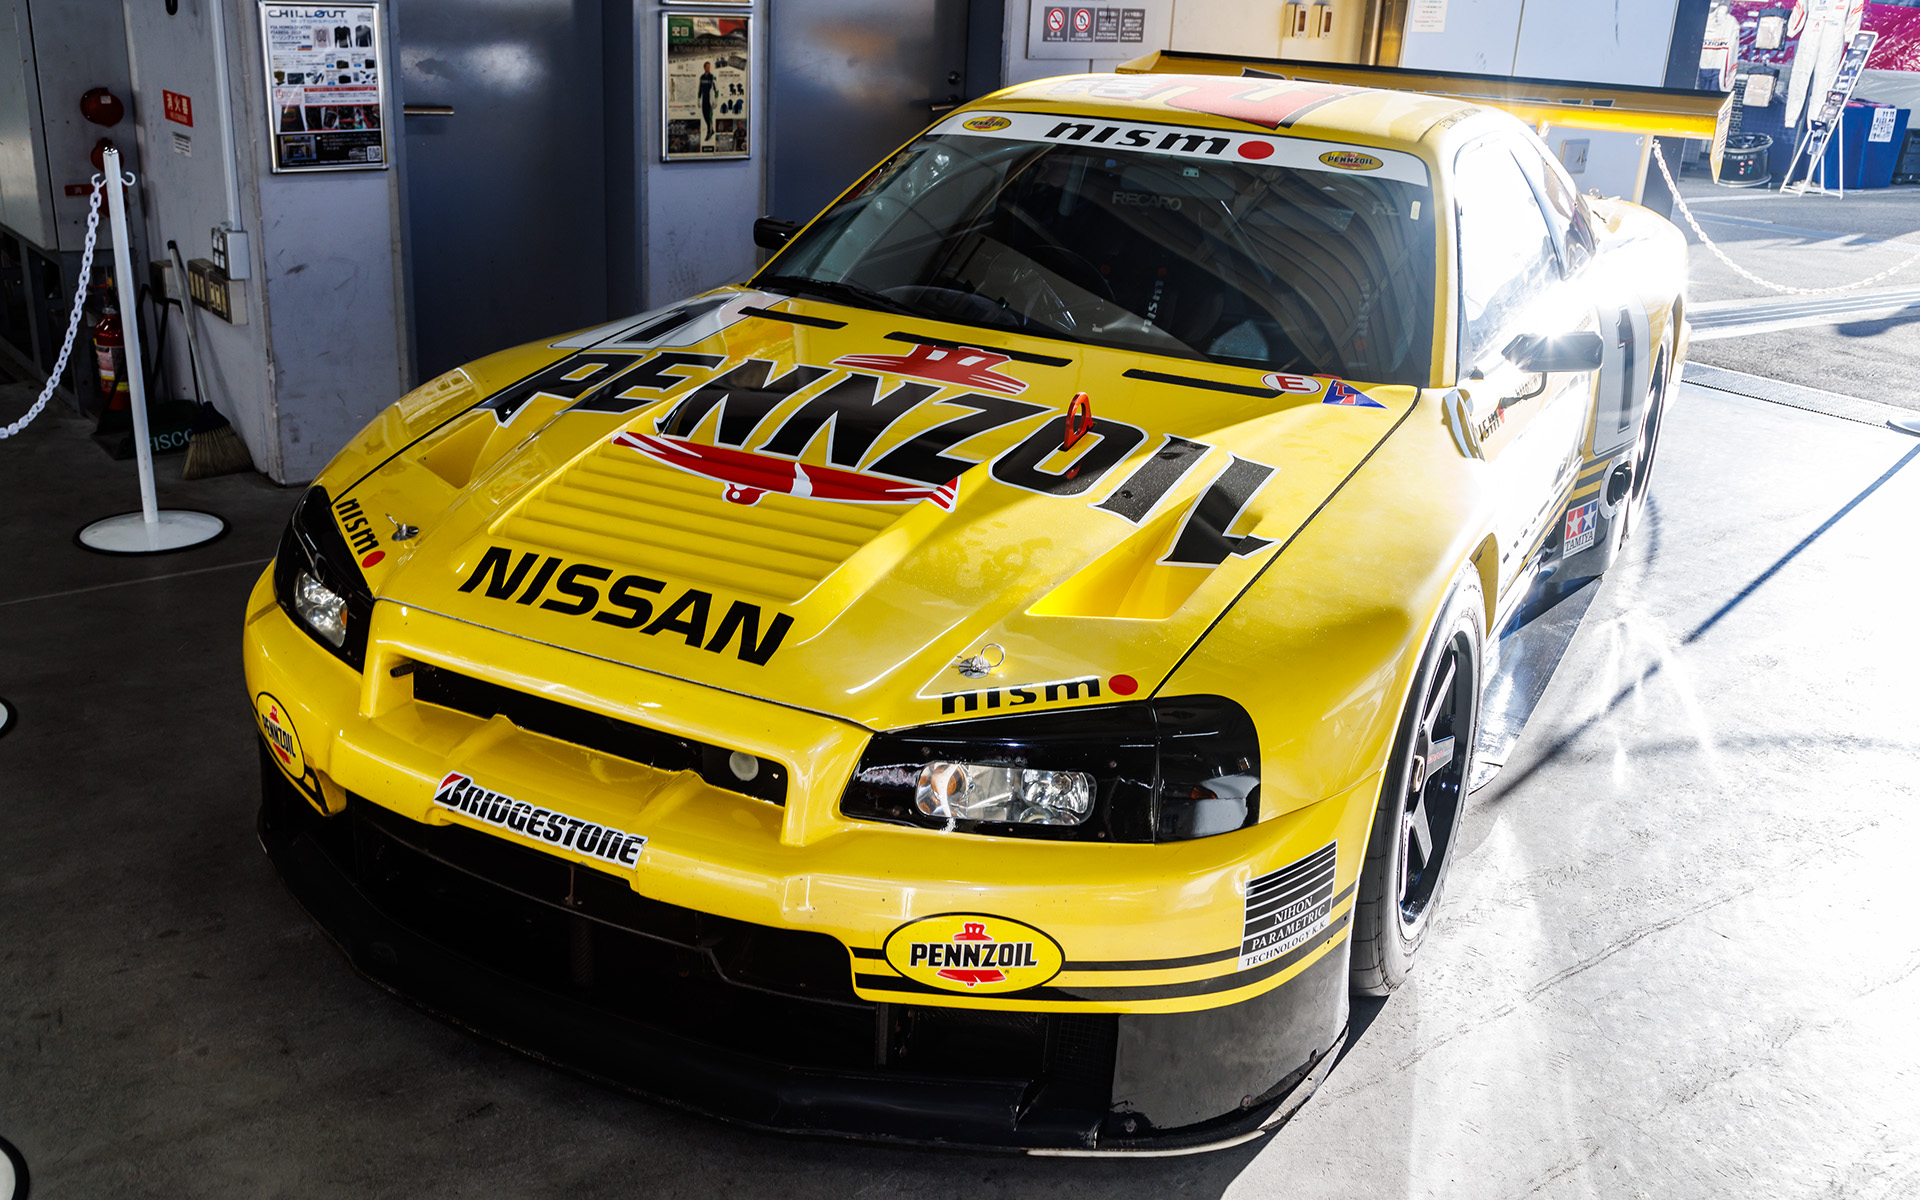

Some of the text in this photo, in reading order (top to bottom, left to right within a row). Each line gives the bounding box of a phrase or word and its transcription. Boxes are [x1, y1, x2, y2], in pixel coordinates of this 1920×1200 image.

[967, 119, 1005, 128] PENNZOIL
[1327, 155, 1375, 165] PENNZOIL
[1112, 191, 1182, 211] RECARO
[1275, 375, 1311, 392] E
[1616, 304, 1637, 434] 1
[149, 427, 193, 452] ISC
[472, 350, 1282, 568] PENNZOIL
[1565, 530, 1594, 552] TAMIYA
[457, 545, 796, 667] NISSAN
[260, 712, 297, 759] PENNZOIL
[433, 772, 648, 866] BRIDGESTONE
[1273, 895, 1314, 926] NIHON
[1251, 904, 1326, 951] PARAMETRIC
[909, 942, 1040, 968] PENNZOIL
[1244, 931, 1310, 967] TECHNOLOGY
